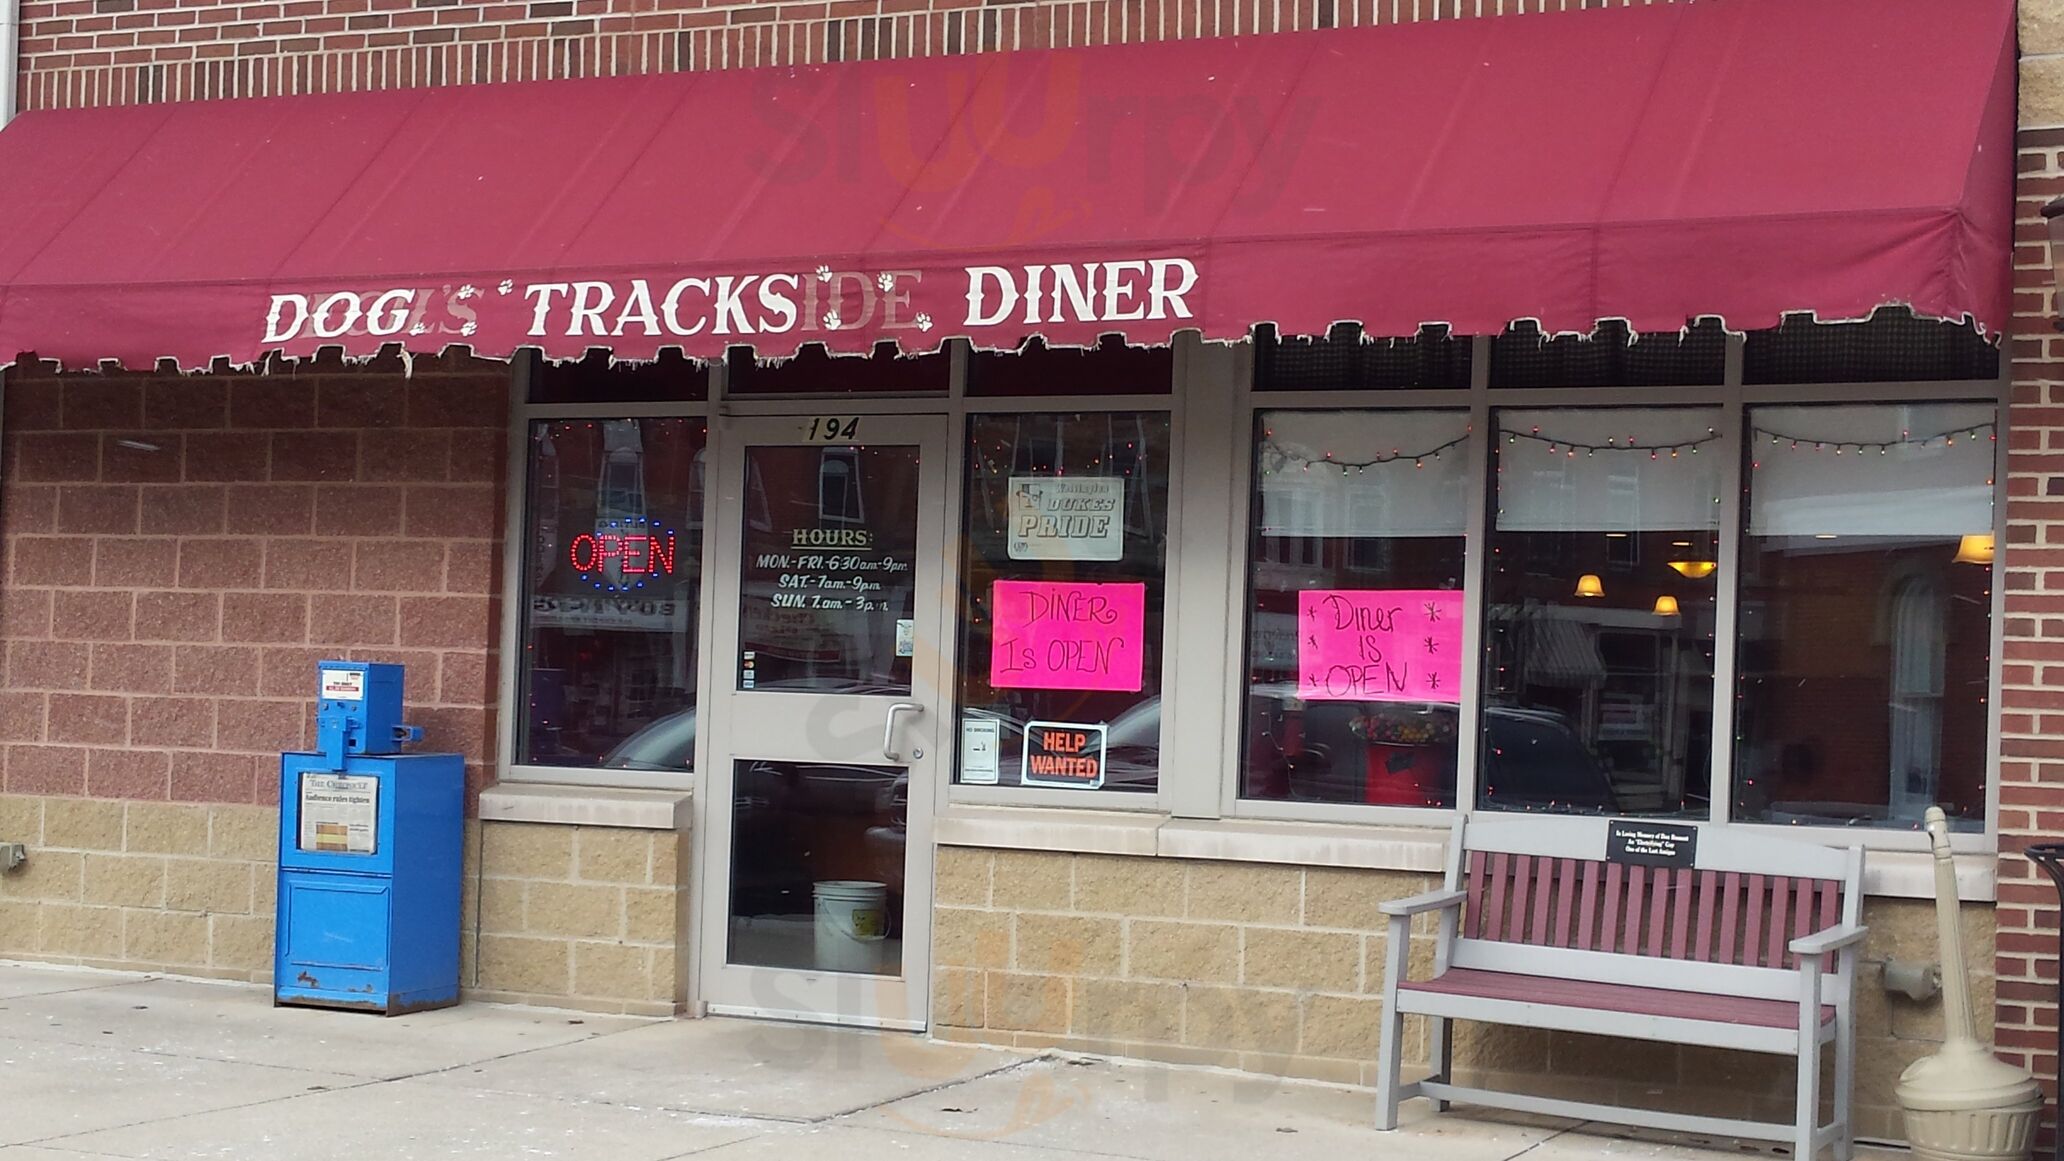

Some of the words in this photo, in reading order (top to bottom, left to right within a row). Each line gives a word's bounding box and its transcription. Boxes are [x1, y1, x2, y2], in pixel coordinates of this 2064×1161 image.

[962, 257, 1200, 327] DINER
[810, 417, 860, 441] 194
[1046, 498, 1116, 512] DUKES
[1018, 514, 1111, 539] PRIDE
[570, 532, 676, 574] OPEN
[770, 593, 806, 608] SUN.
[1322, 594, 1403, 633] Diner
[1047, 637, 1125, 675] OPEN
[1326, 661, 1408, 697] OPEN
[1043, 731, 1087, 753] HELP
[1030, 755, 1099, 778] WANTED
